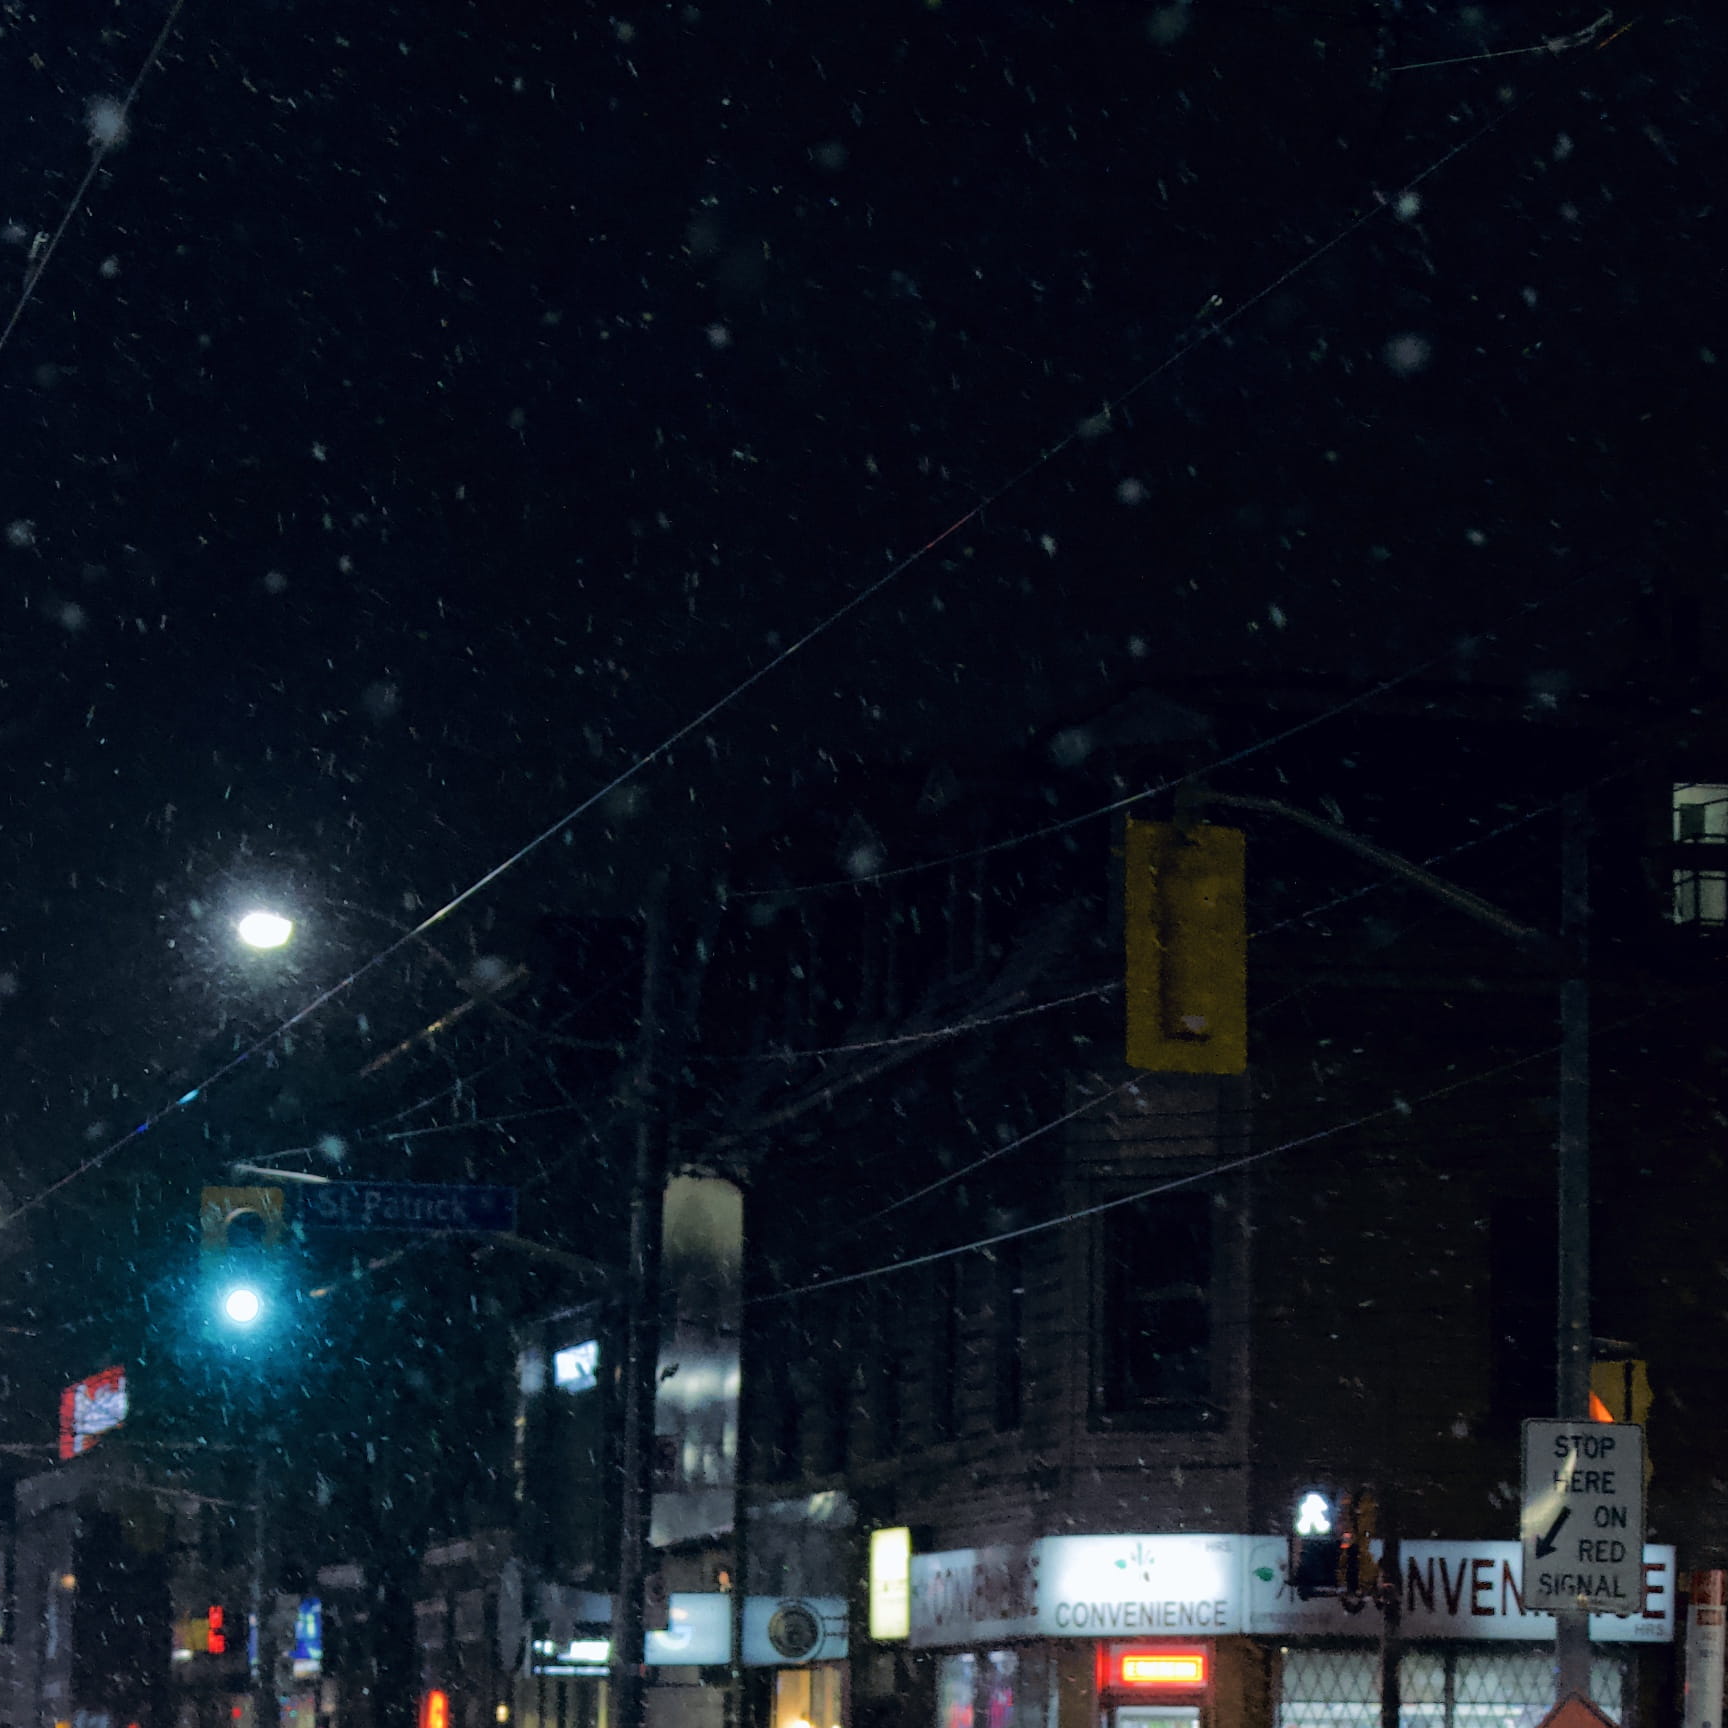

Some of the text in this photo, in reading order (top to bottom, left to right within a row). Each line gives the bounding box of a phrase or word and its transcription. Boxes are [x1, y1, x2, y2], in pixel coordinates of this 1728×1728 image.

[1554, 1434, 1616, 1459] STOP
[1553, 1470, 1616, 1494] HERE
[1595, 1505, 1627, 1528] ON
[1578, 1539, 1625, 1563] RED
[1538, 1574, 1627, 1598] SIGNAL
[1055, 1599, 1228, 1630] CONVENIENCE
